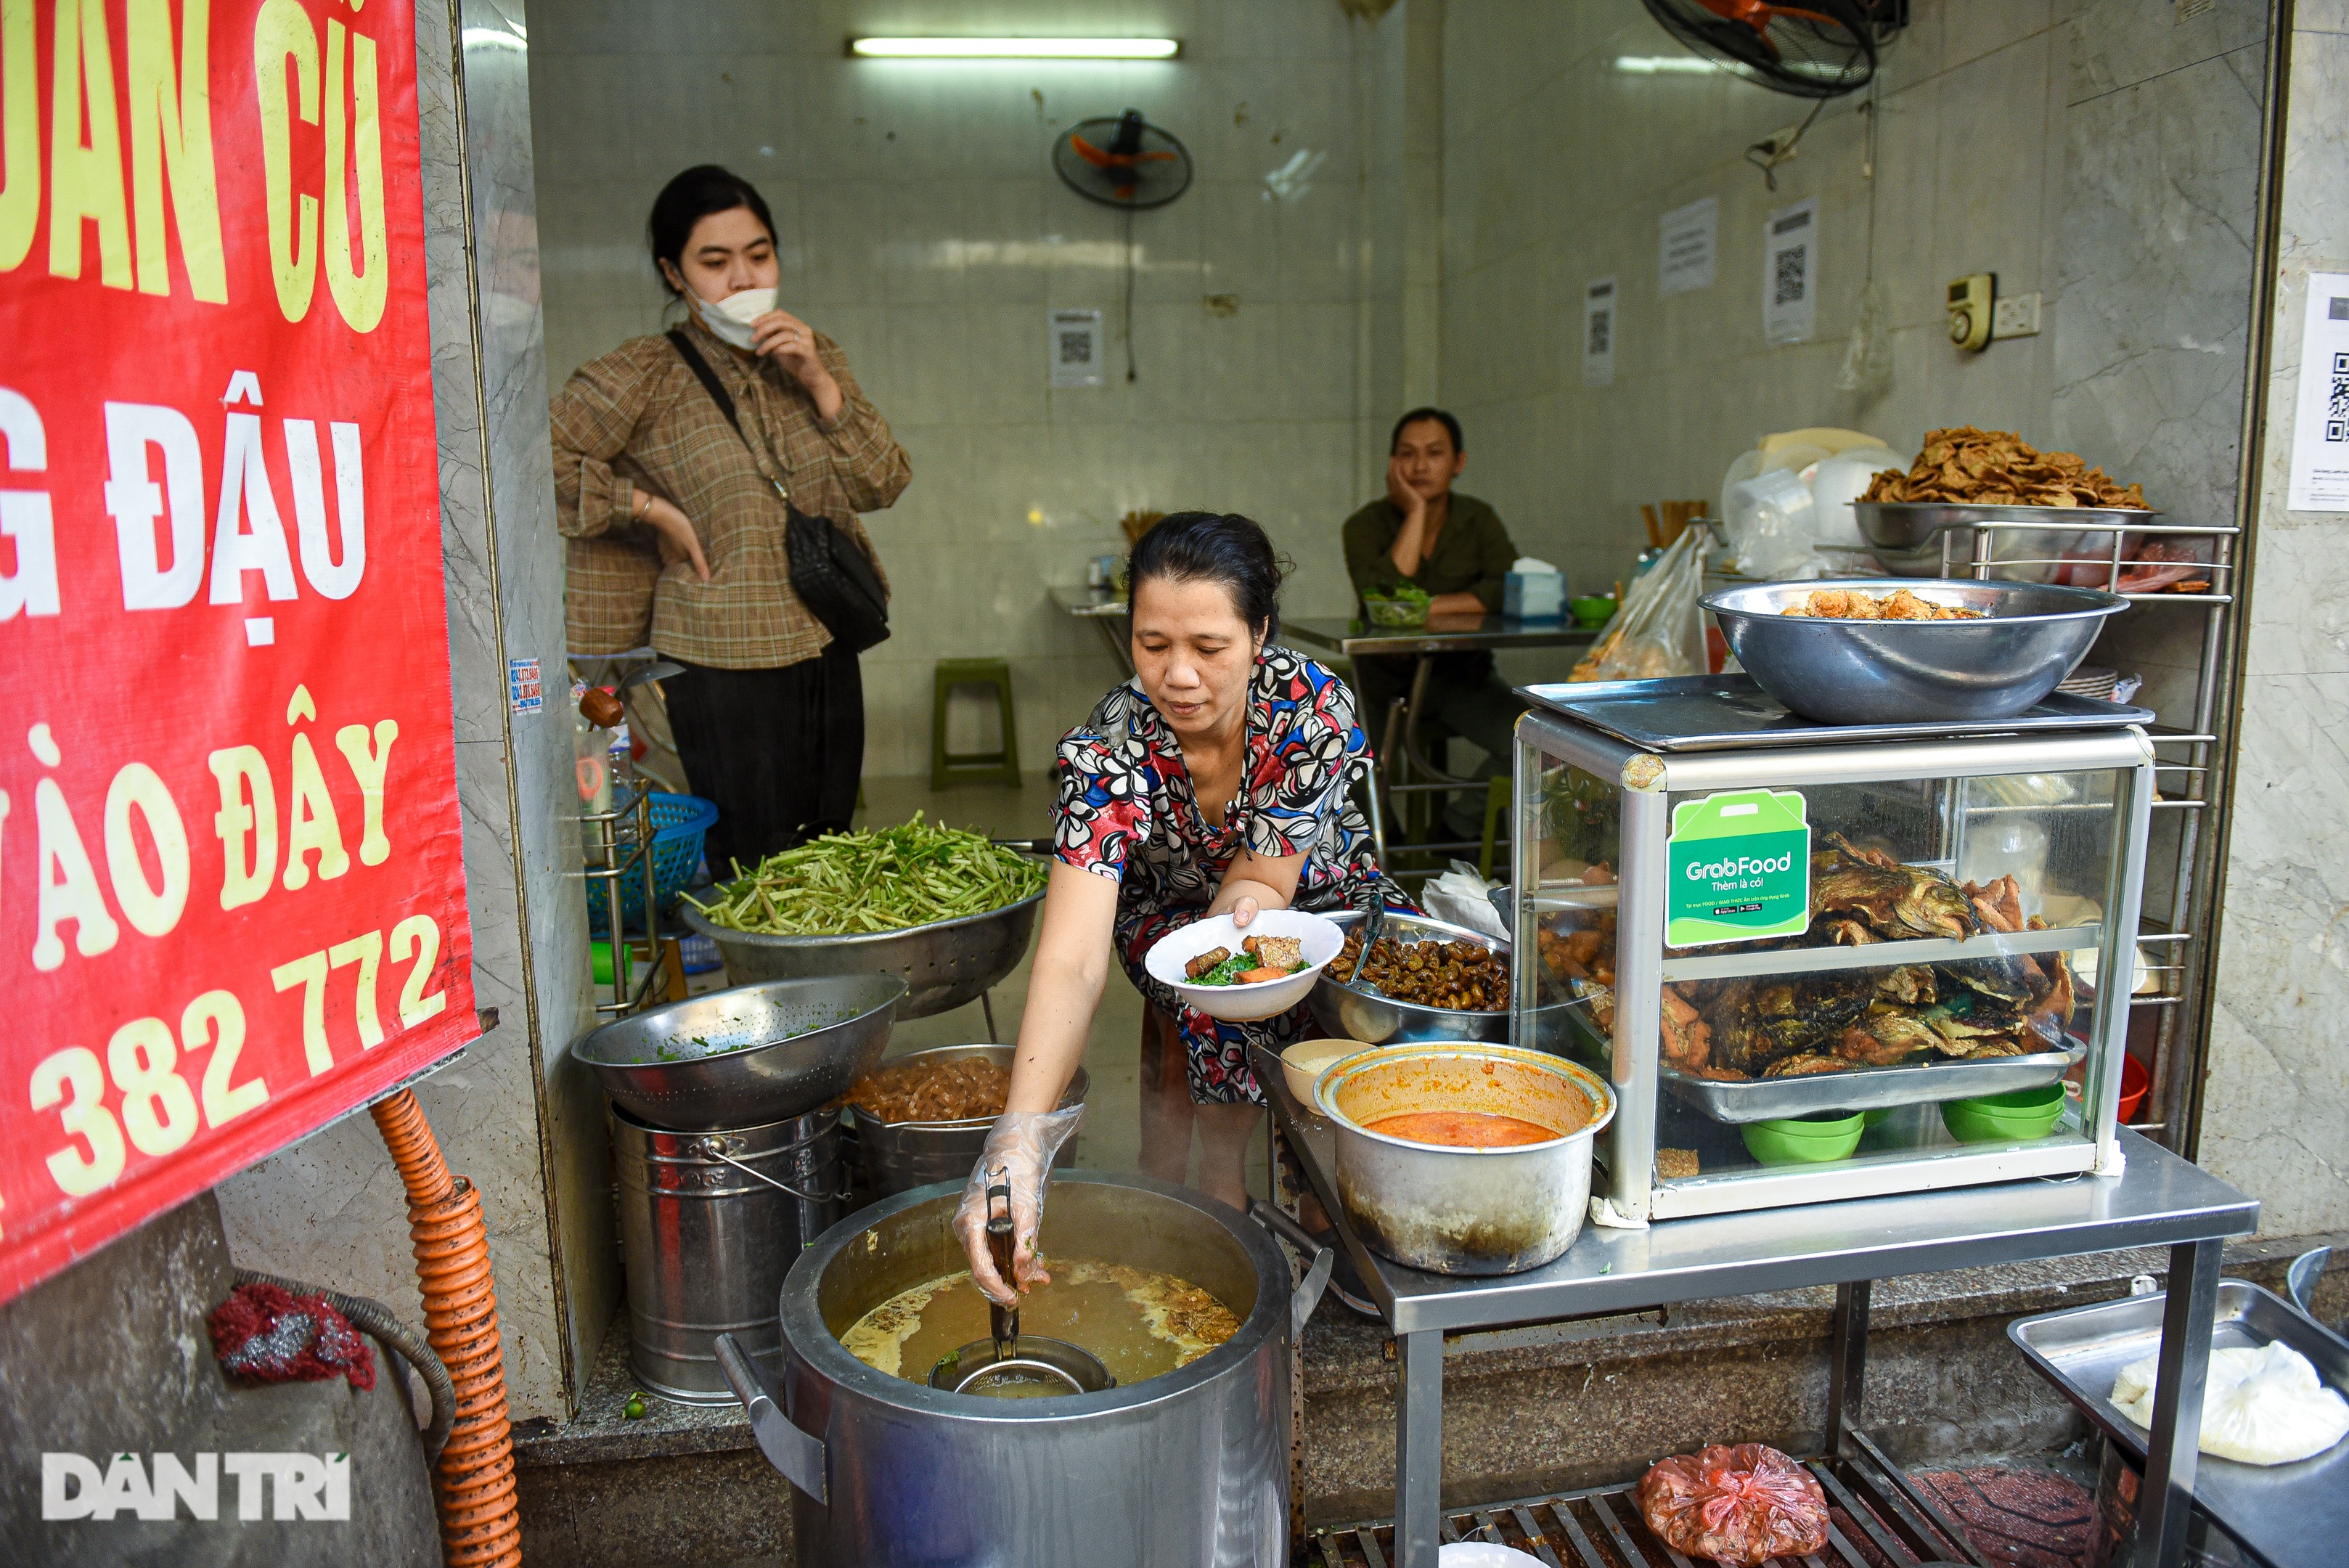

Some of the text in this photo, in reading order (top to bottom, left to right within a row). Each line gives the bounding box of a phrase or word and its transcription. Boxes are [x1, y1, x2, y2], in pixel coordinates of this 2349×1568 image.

[105, 369, 367, 648] ĐẬU
[0, 684, 399, 971] ÀO ĐÂY
[1686, 851, 1791, 881] GrabFood
[1711, 876, 1764, 892] Thèm là có!
[30, 914, 446, 1198] 382 772
